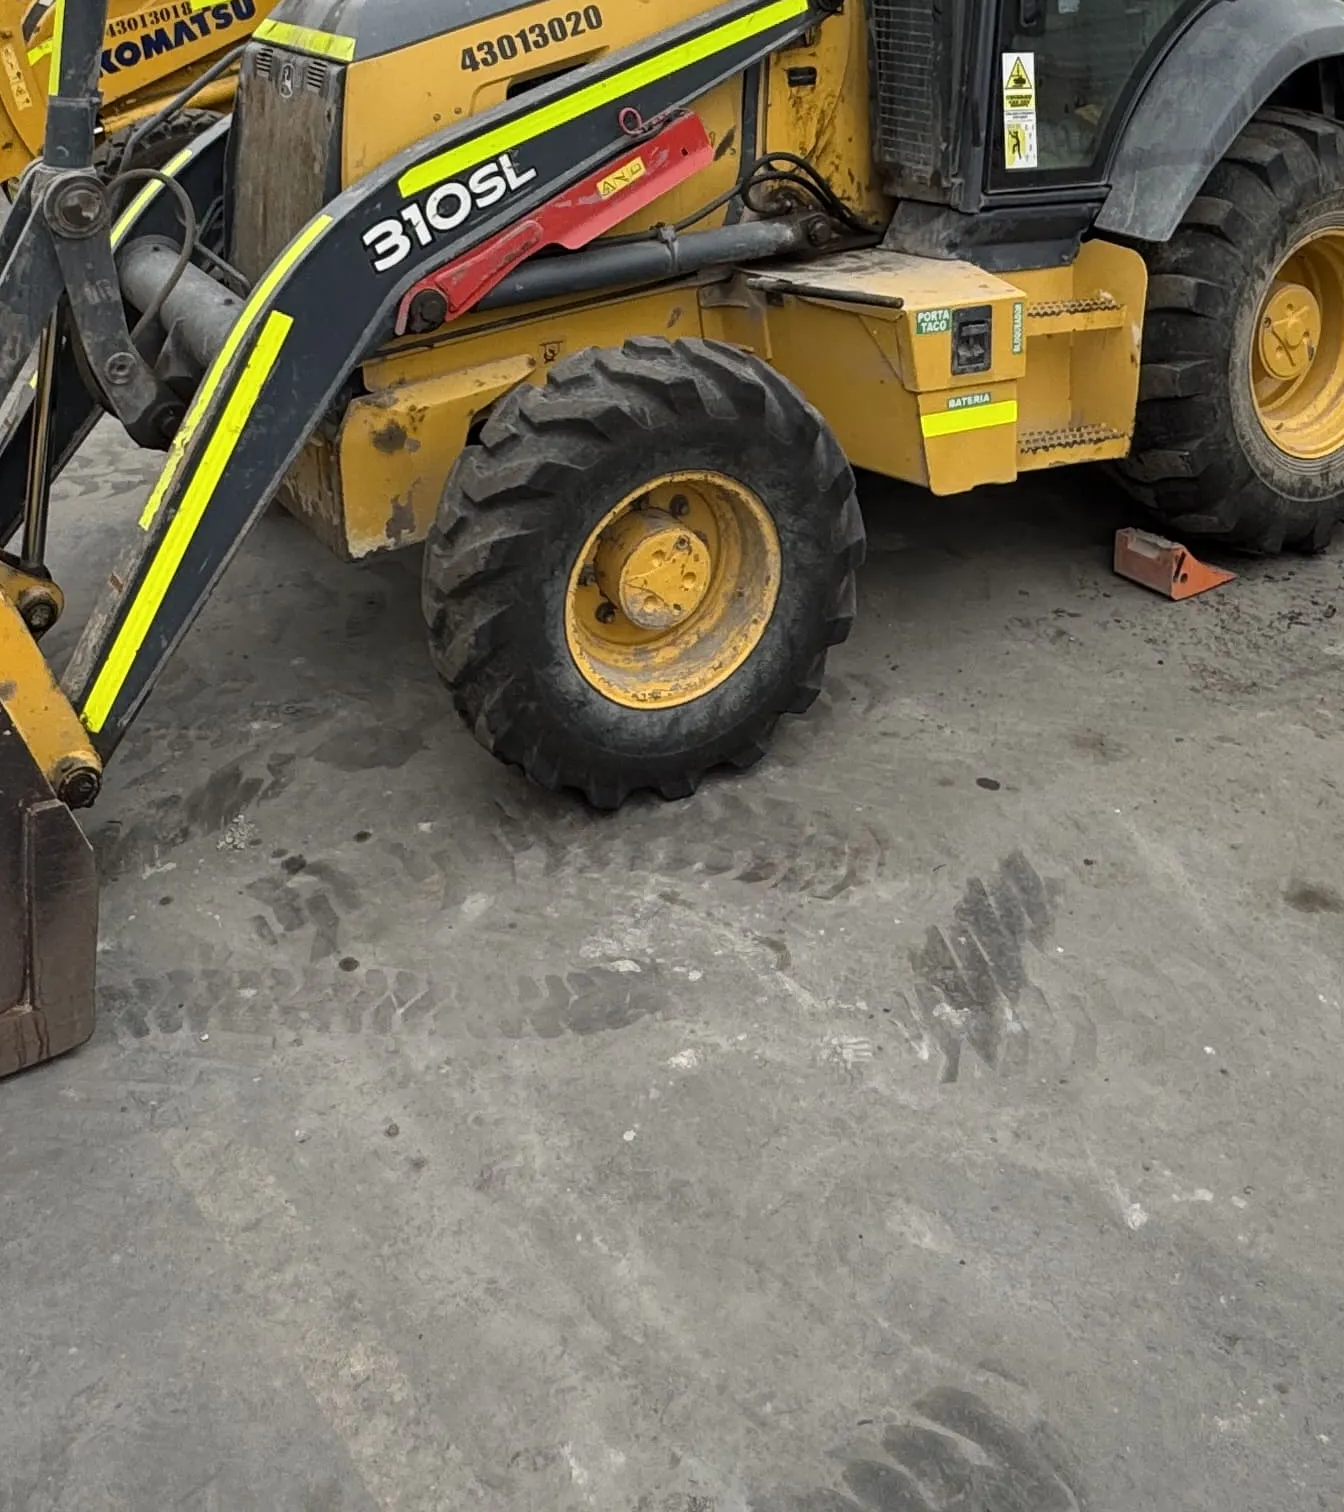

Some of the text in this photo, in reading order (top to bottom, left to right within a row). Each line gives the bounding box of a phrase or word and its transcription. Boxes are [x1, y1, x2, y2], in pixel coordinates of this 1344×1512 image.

[460, 4, 603, 73] 43013020
[362, 152, 538, 273] 310SL
[917, 309, 950, 324] PORTA
[920, 321, 947, 334] TACO
[948, 393, 991, 409] BATERIA
